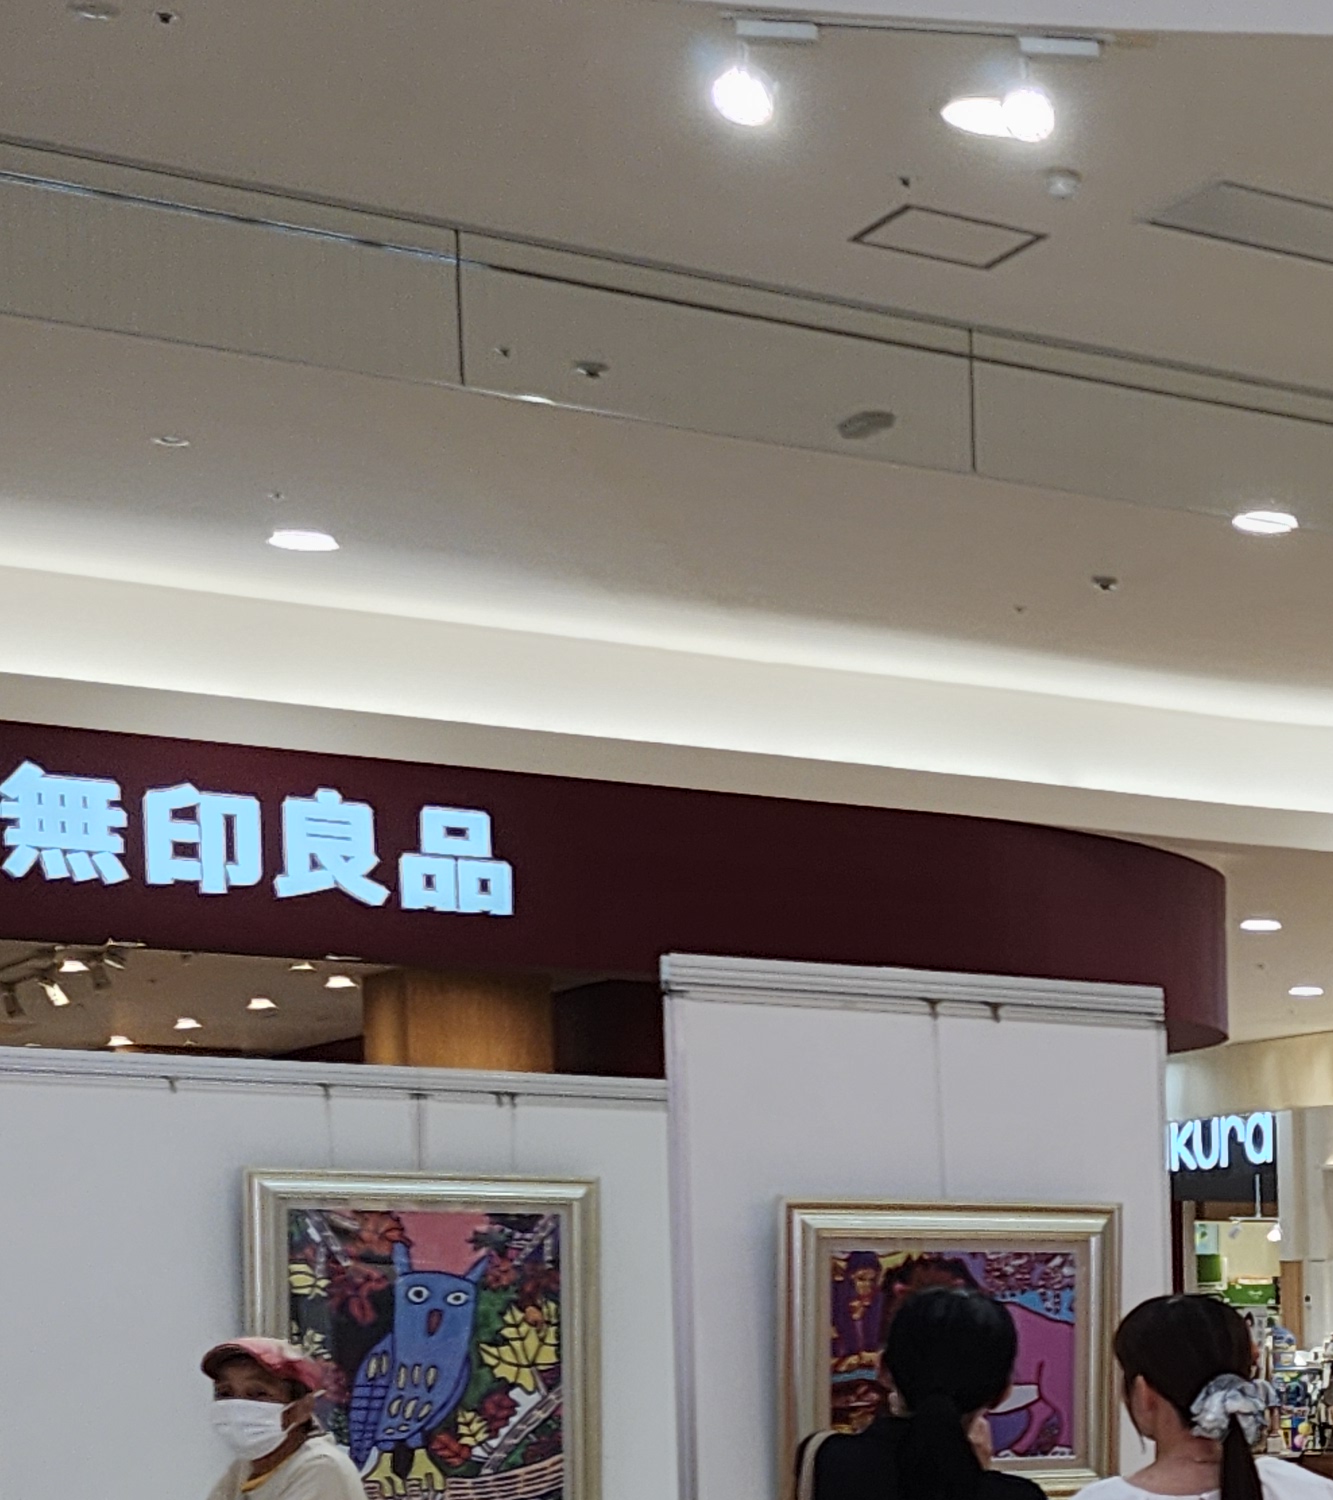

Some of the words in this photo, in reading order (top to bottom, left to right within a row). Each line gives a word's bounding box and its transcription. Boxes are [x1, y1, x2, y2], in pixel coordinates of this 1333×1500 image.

[0, 759, 515, 916] 無印良品
[1167, 1111, 1273, 1172] kura
